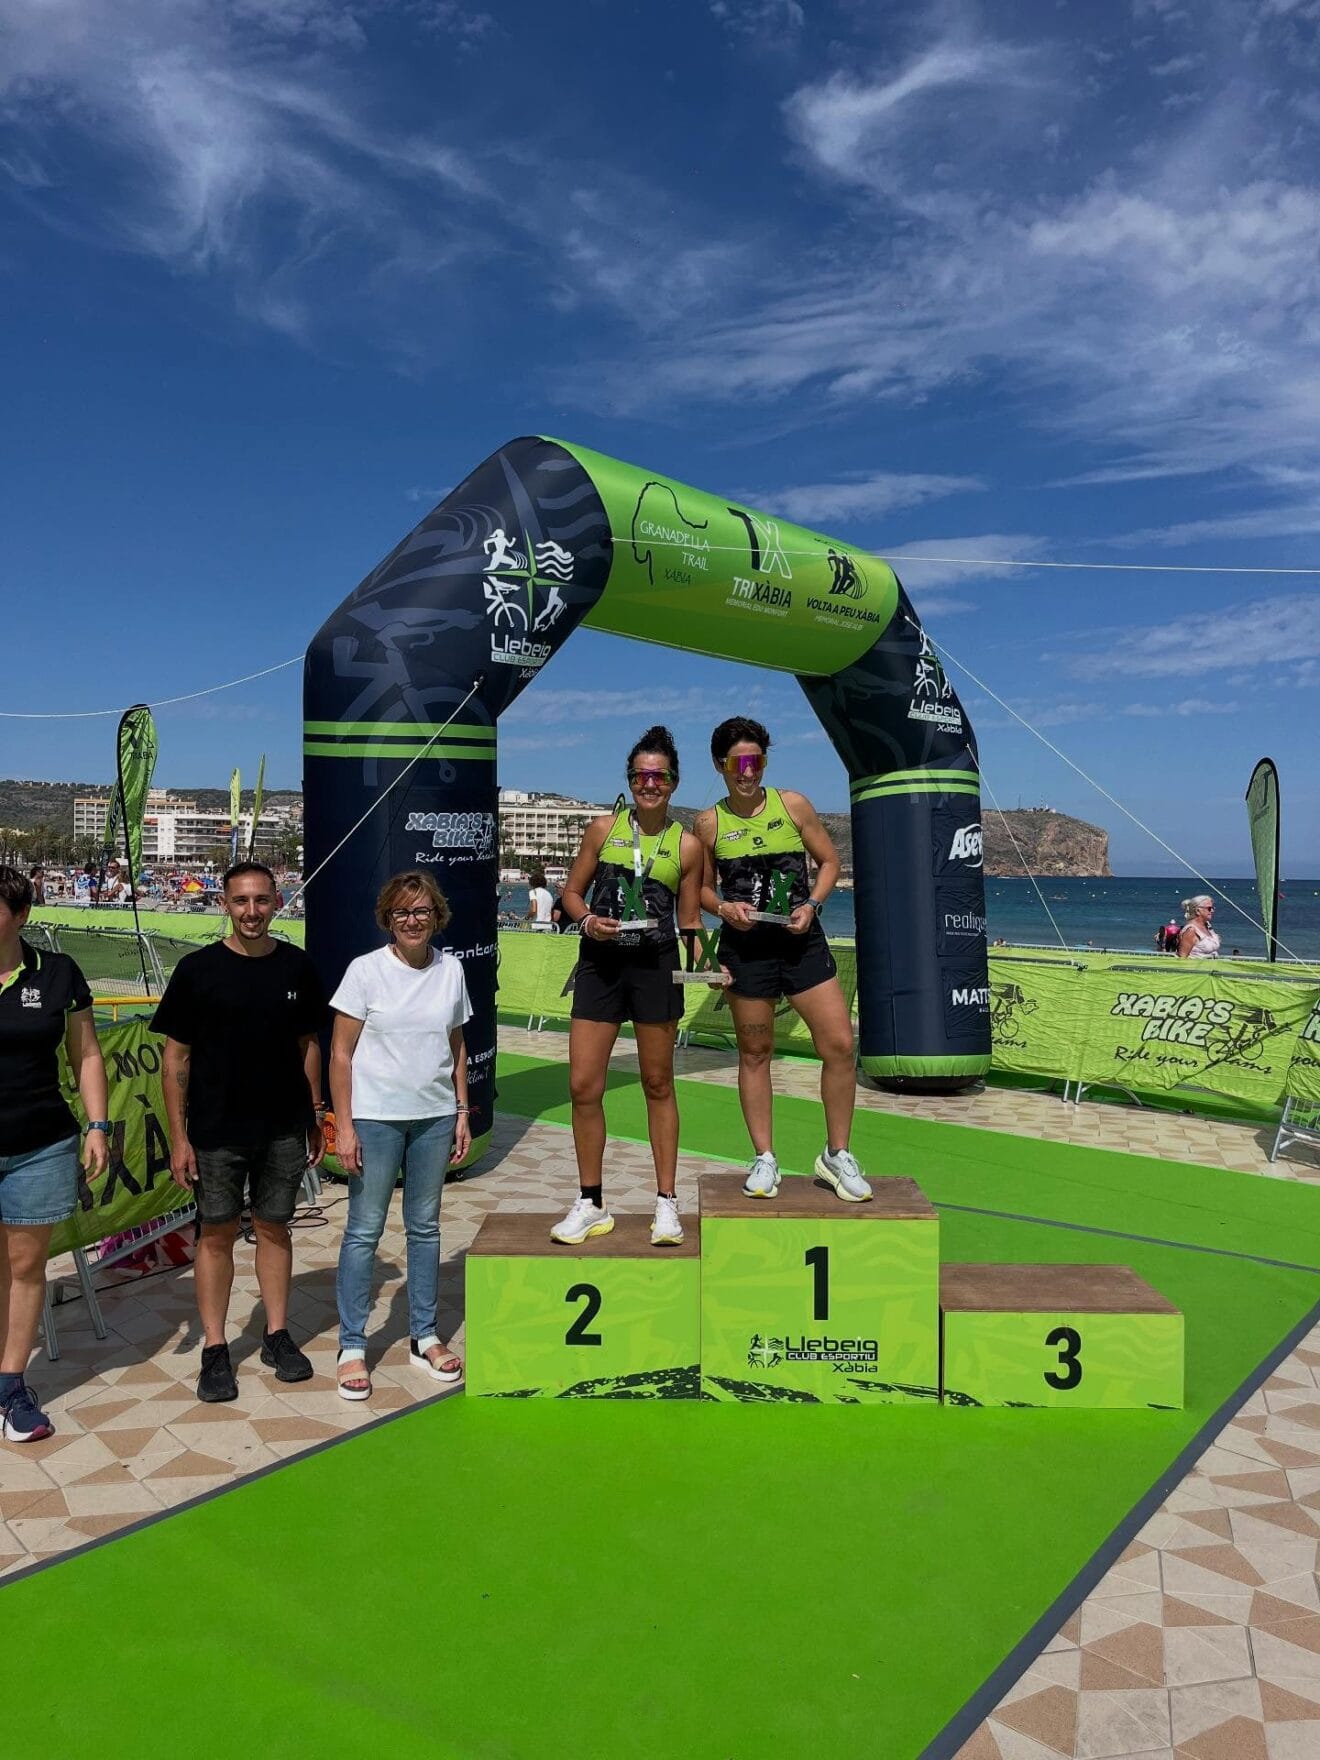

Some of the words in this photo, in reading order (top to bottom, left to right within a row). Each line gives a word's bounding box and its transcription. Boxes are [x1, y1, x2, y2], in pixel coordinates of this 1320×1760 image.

[640, 520, 710, 552] GRANADELLA
[682, 551, 709, 571] TRAIL
[732, 576, 792, 609] TRIXÀBIA
[806, 598, 832, 613] VOLTA
[832, 604, 839, 614] A
[839, 605, 856, 618] PEU
[490, 633, 552, 658] Llebeig
[909, 699, 961, 720] Llebeig
[405, 812, 483, 831] XABIA'S
[432, 830, 477, 848] BIKE
[415, 852, 445, 863] Ride
[448, 855, 474, 866] your
[1110, 992, 1236, 1025] XABIA'S
[1141, 1018, 1216, 1049] BIKE
[1114, 1045, 1150, 1062] Ride
[1156, 1054, 1200, 1068] your
[805, 1246, 829, 1321] 1
[564, 1283, 602, 1346] 2
[785, 1336, 878, 1353] Llebeig
[788, 1352, 818, 1360] CLUB
[820, 1352, 876, 1361] ESPORTIU
[832, 1361, 878, 1373] Xàbia
[1043, 1326, 1082, 1390] 3
